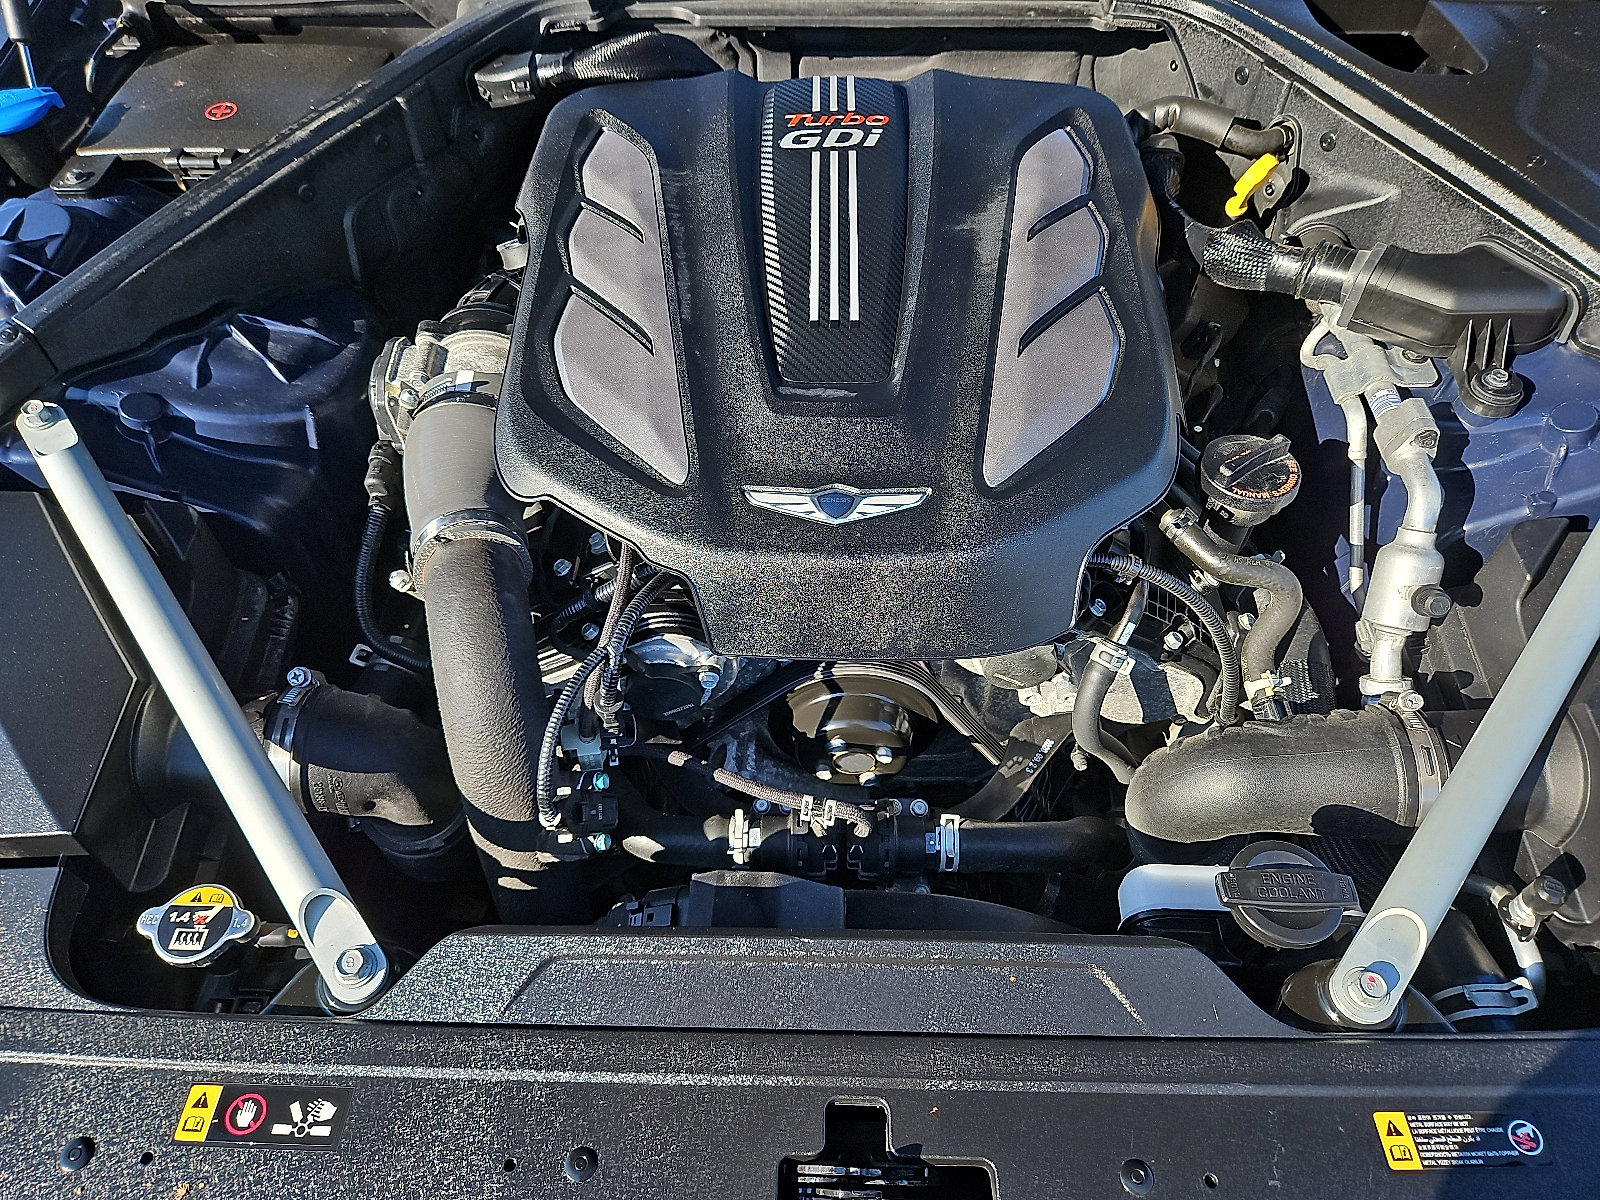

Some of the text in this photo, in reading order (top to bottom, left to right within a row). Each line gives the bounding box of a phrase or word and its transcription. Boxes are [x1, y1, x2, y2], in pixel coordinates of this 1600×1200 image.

[784, 112, 890, 127] Turbo
[778, 128, 884, 149] GDi
[1286, 459, 1298, 473] SEE
[1232, 486, 1271, 499] MANUAL
[1260, 872, 1317, 886] ENGINE
[1256, 886, 1327, 900] COOLANT
[169, 911, 191, 923] 1.4
[232, 917, 249, 928] 1.4
